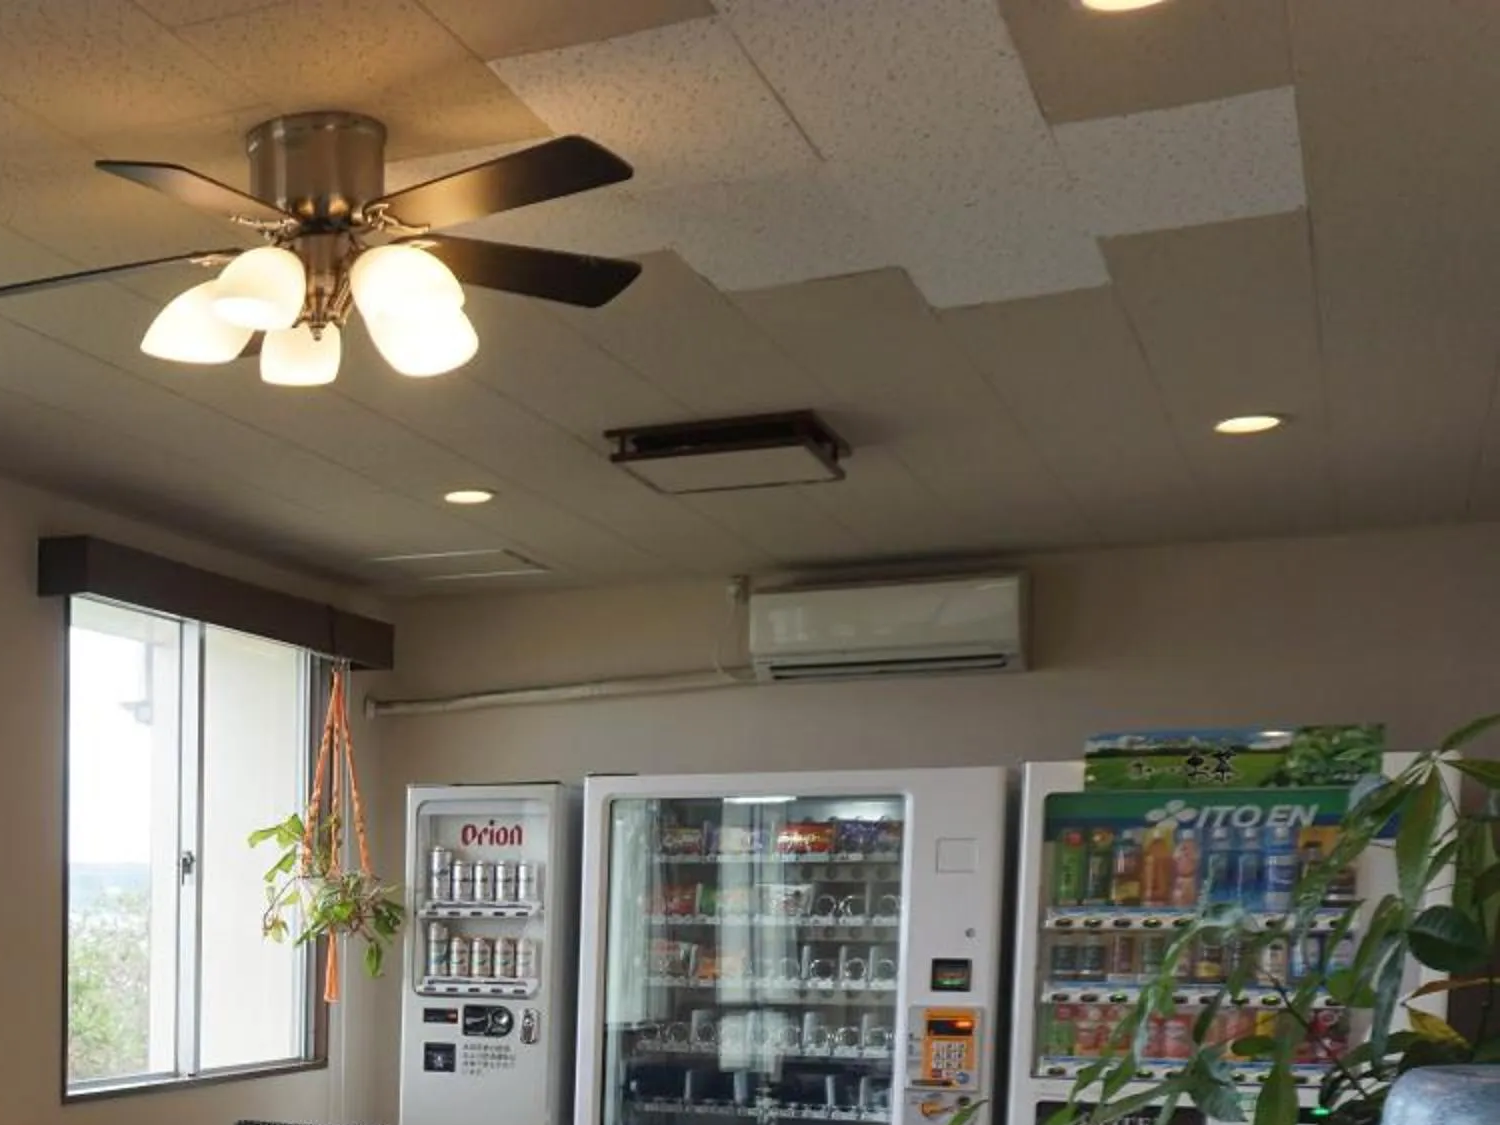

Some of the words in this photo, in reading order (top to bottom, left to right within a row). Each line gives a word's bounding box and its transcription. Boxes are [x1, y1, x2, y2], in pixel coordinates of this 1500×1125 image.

[1196, 804, 1263, 828] ITO
[1266, 803, 1320, 828] EN
[461, 819, 523, 846] Orion
